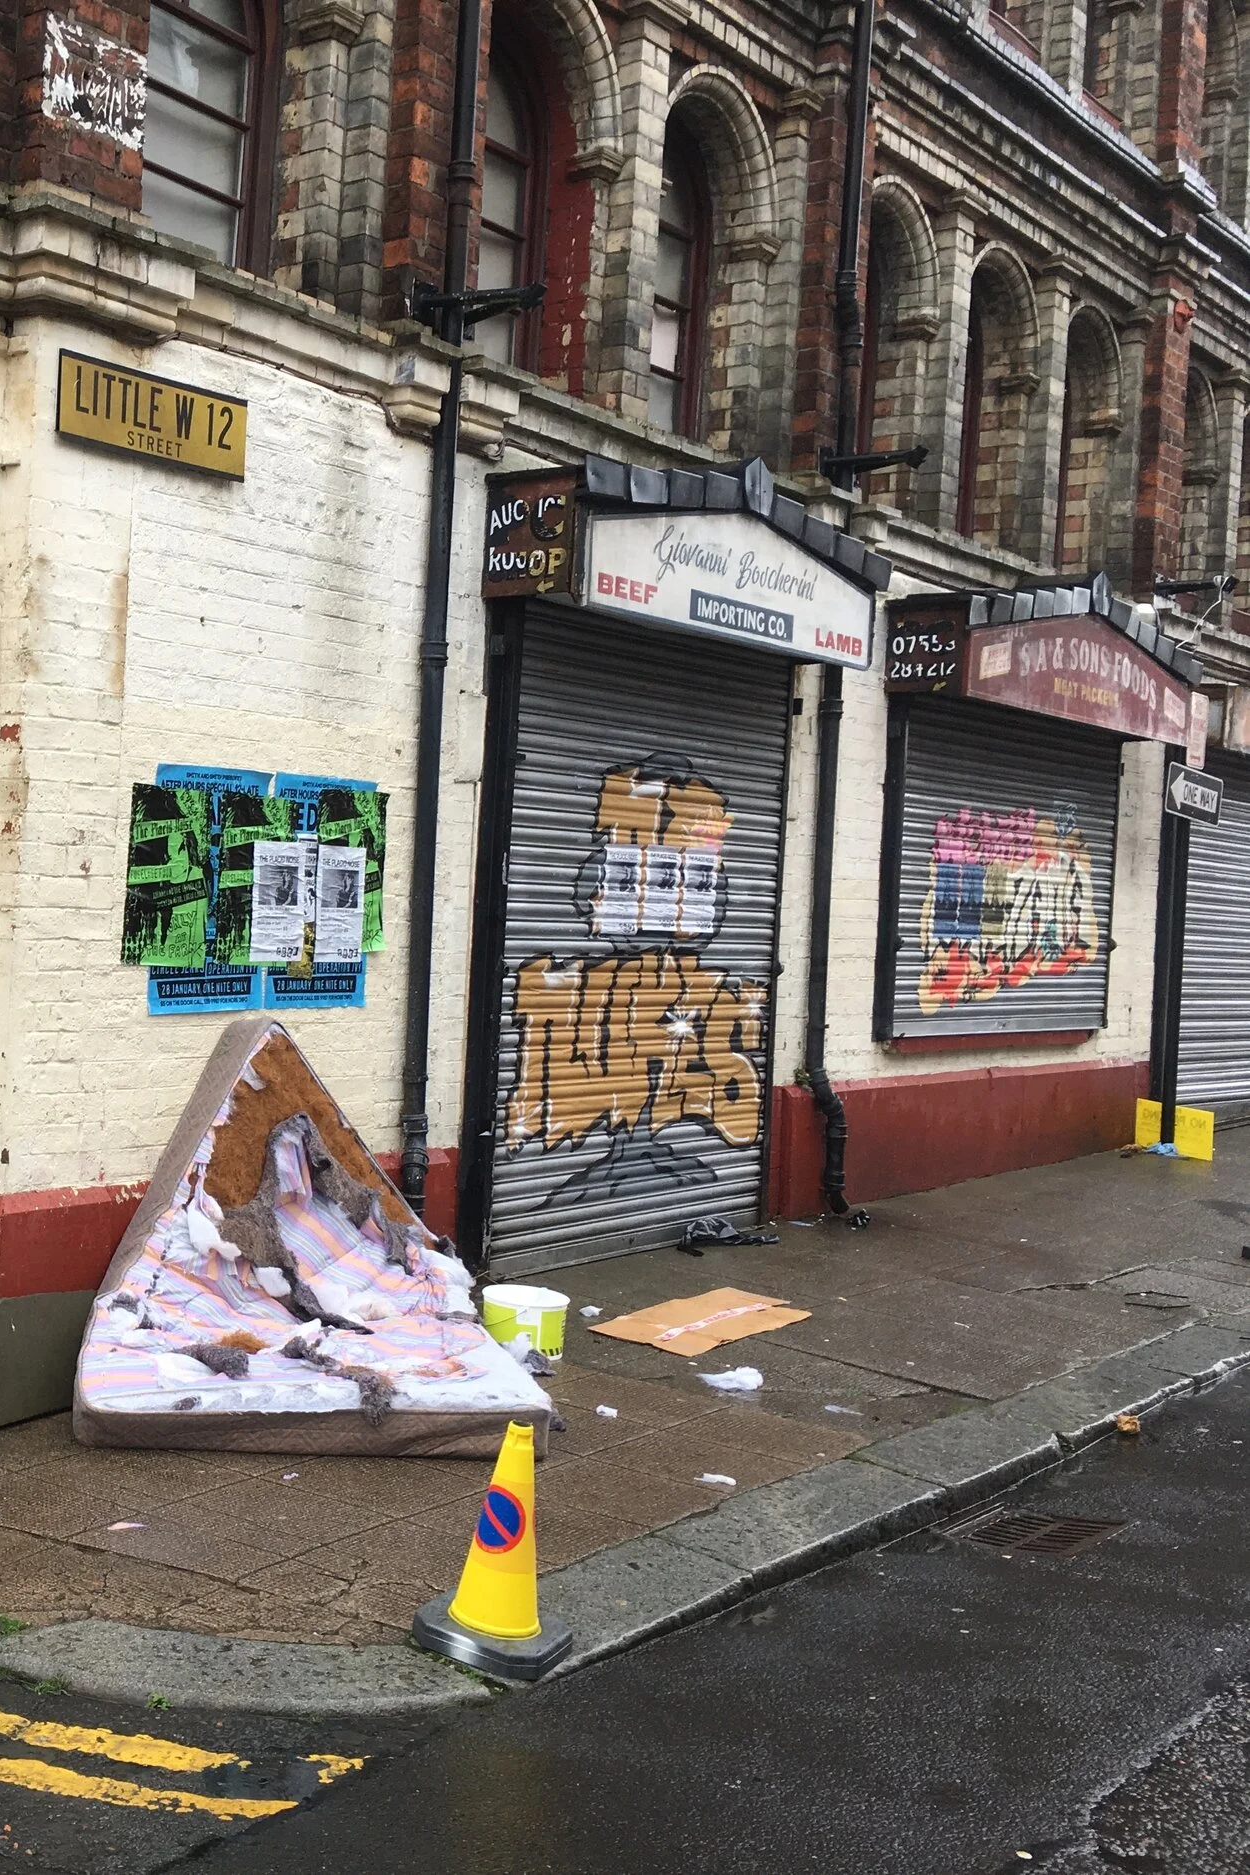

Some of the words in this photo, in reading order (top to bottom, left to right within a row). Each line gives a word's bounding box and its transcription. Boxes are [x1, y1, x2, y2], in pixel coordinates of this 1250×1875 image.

[75, 365, 162, 434] LITTLE
[175, 395, 195, 441] W
[207, 403, 232, 451] 12
[126, 429, 183, 459] STREET
[654, 524, 732, 582] Giovanni
[597, 571, 659, 604] BEEF
[696, 598, 765, 633] IMPORTING
[768, 612, 787, 640] CO.
[814, 627, 863, 657] LAMB
[1053, 638, 1063, 669] &
[1070, 638, 1108, 677] SONS
[1113, 652, 1156, 710] FOODS
[1054, 678, 1077, 698] MEAT
[161, 780, 181, 790] AFTER
[183, 781, 206, 792] HOURS
[206, 782, 233, 793] SPECIAL
[279, 788, 298, 799] AFTER
[299, 790, 319, 800] HOURS
[1184, 784, 1198, 804] ONE
[1200, 789, 1216, 810] WAY
[171, 982, 201, 996] JANUARY
[202, 982, 214, 994] ONE
[216, 981, 230, 994] NITE
[232, 981, 248, 993] ONLY
[286, 980, 312, 991] JANUARY
[339, 979, 354, 990] ONLY
